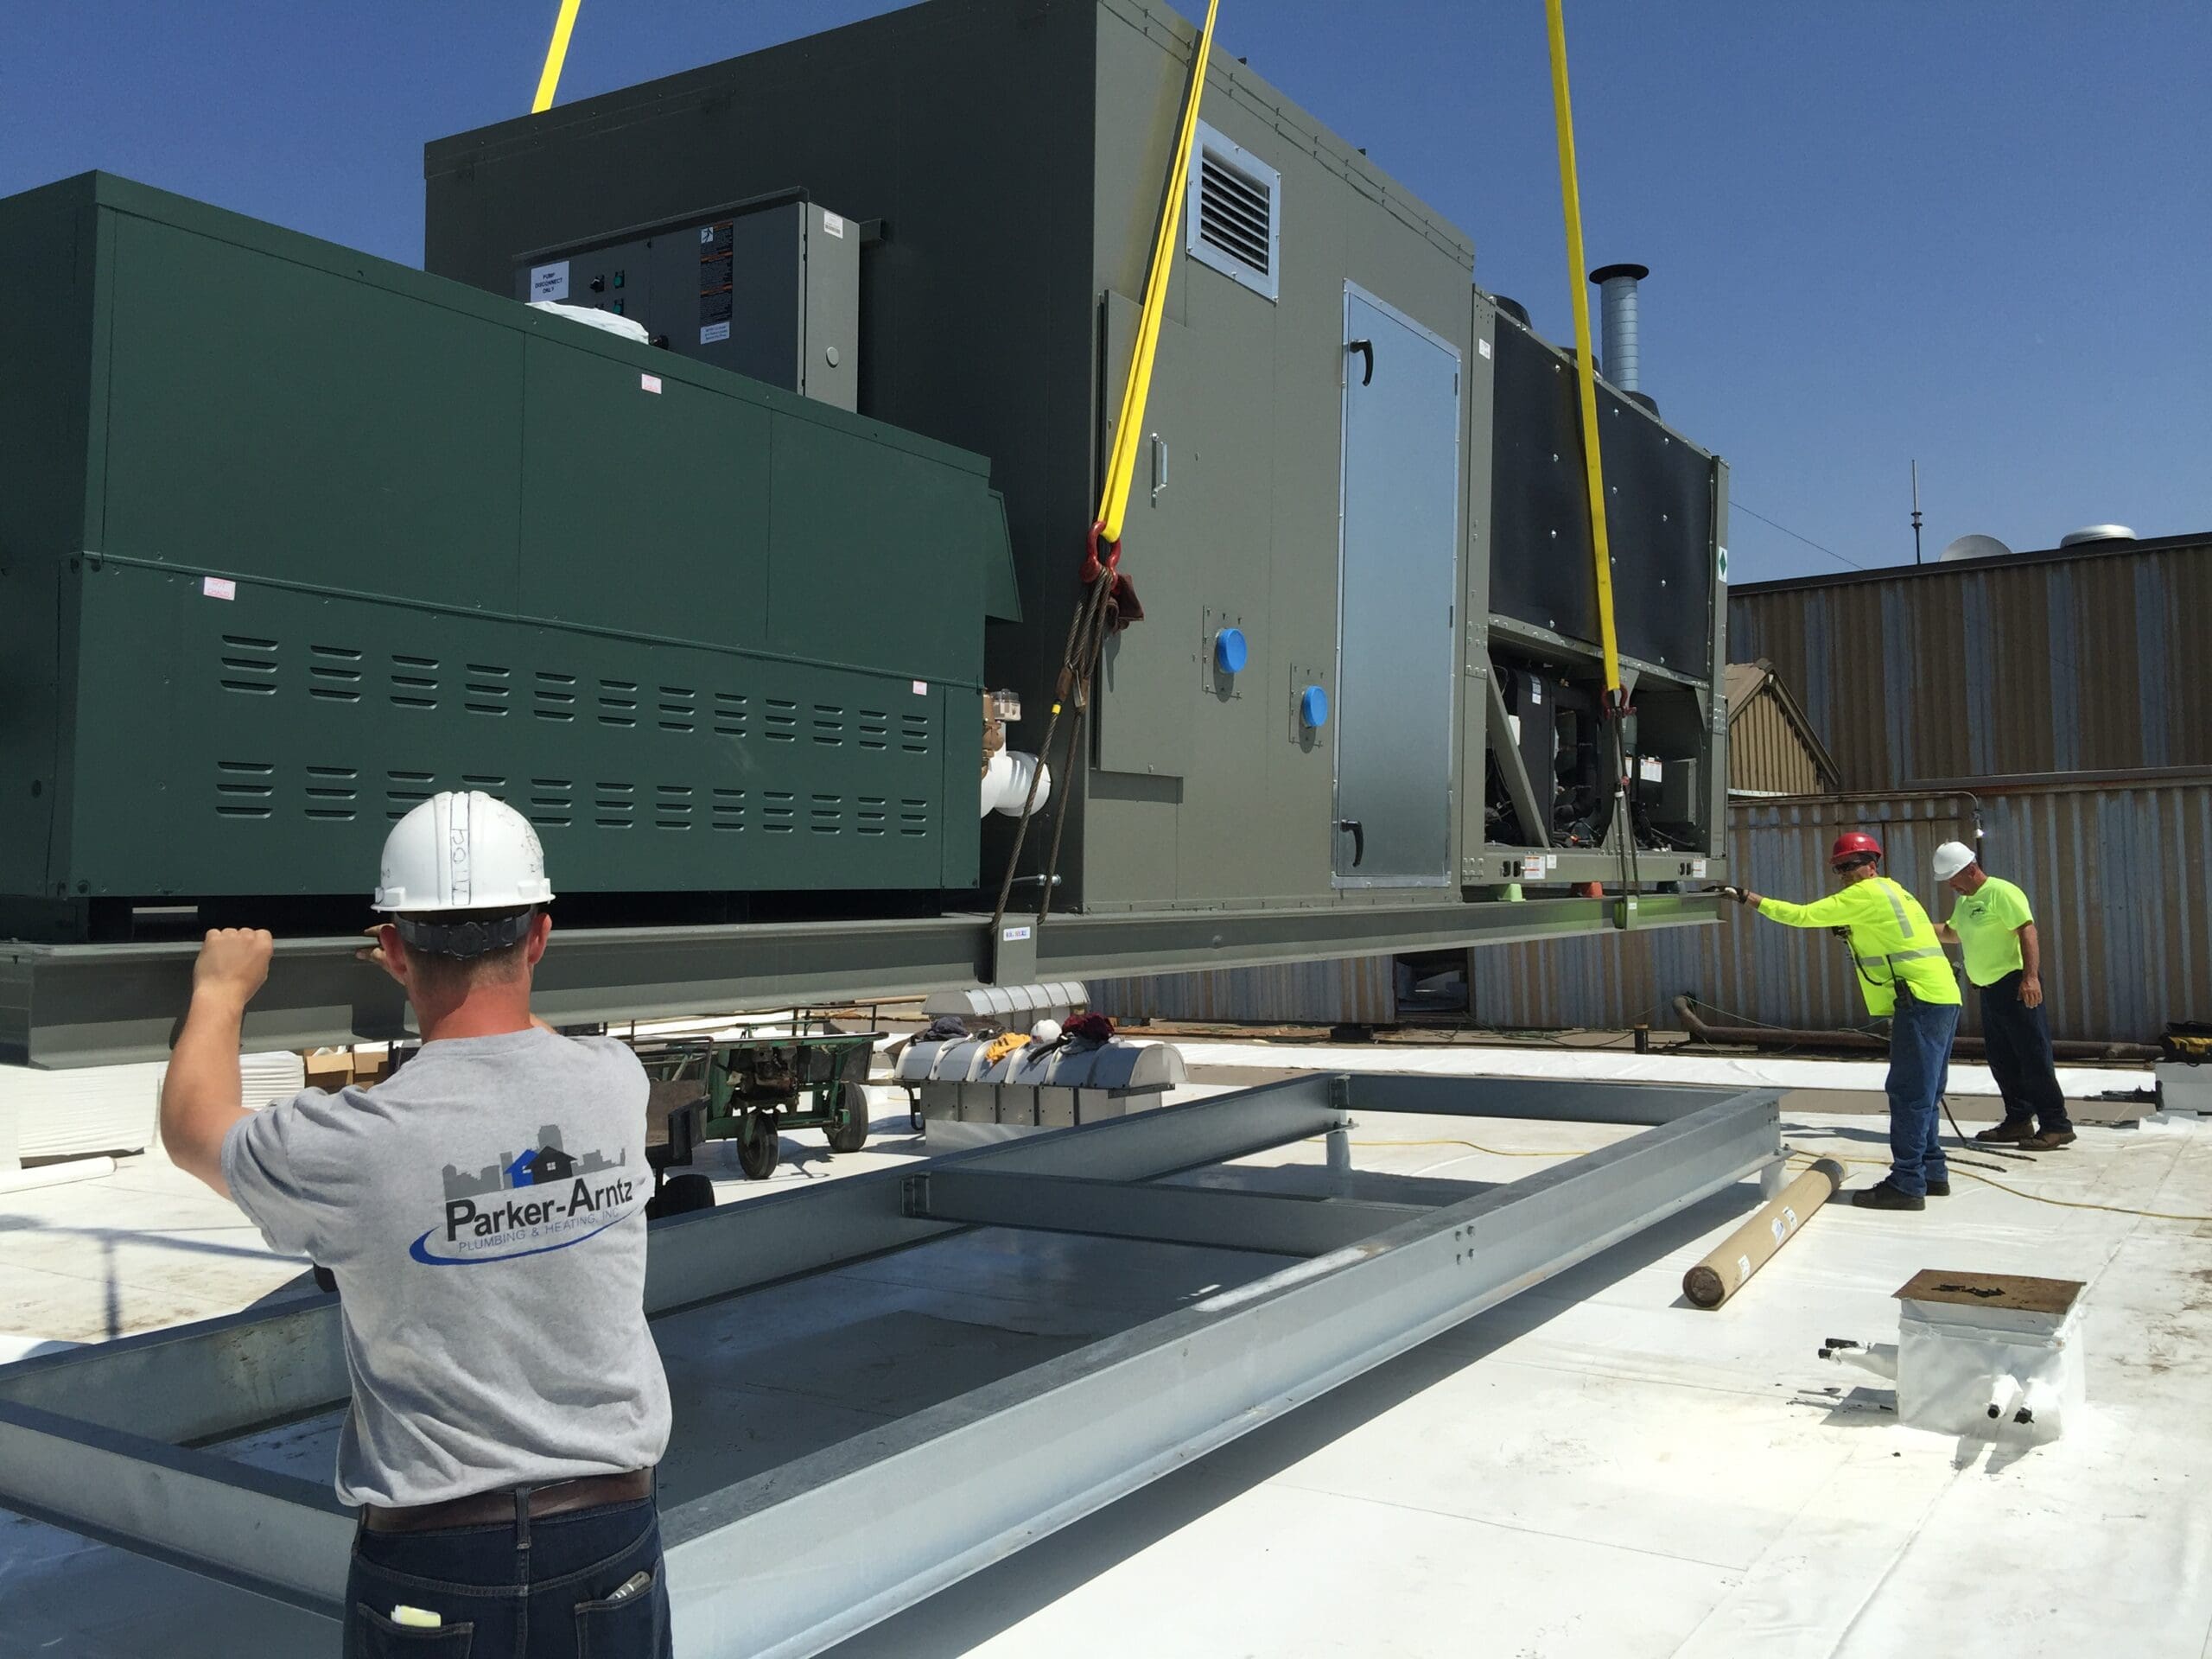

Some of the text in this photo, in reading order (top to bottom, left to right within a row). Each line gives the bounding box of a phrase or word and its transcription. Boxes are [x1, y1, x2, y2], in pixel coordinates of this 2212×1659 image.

[446, 1177, 632, 1243] Parker-Arntz
[459, 1230, 525, 1252] PLUMBING
[531, 1227, 540, 1237] &
